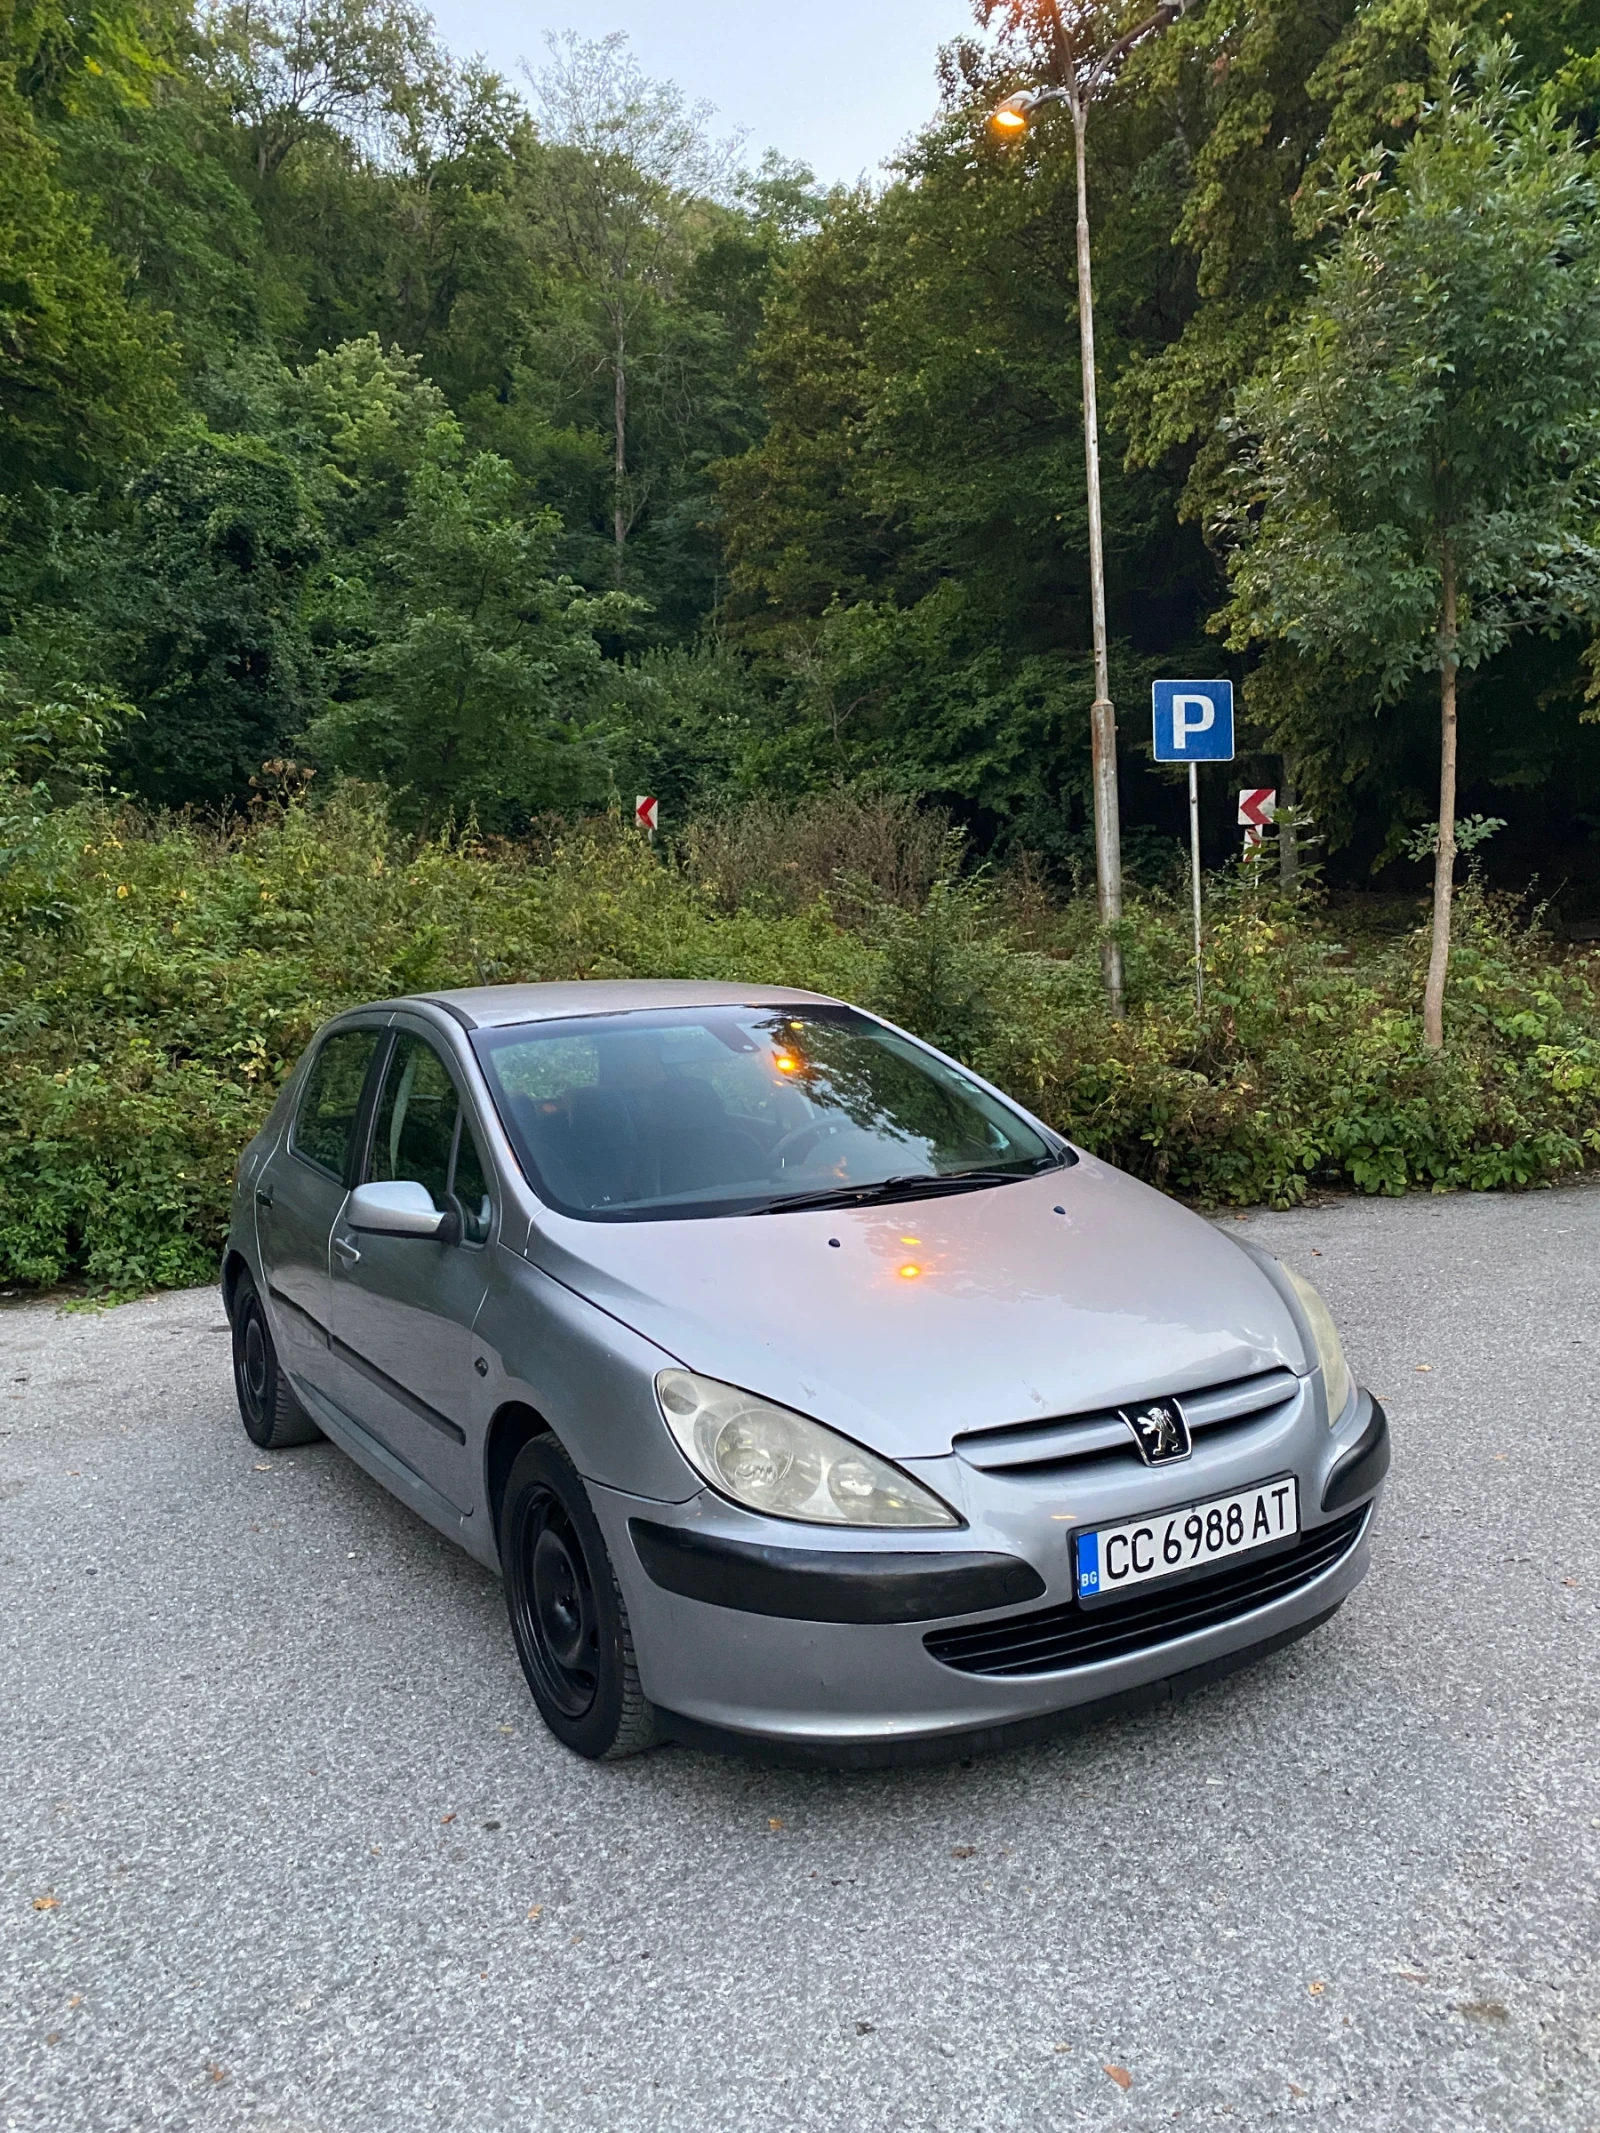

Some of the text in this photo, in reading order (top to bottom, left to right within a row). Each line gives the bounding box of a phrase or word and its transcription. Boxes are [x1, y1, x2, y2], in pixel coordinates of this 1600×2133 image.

[1173, 695, 1215, 749] P
[1106, 1487, 1289, 1580] CC 6988 AT
[1081, 1571, 1097, 1587] BG
